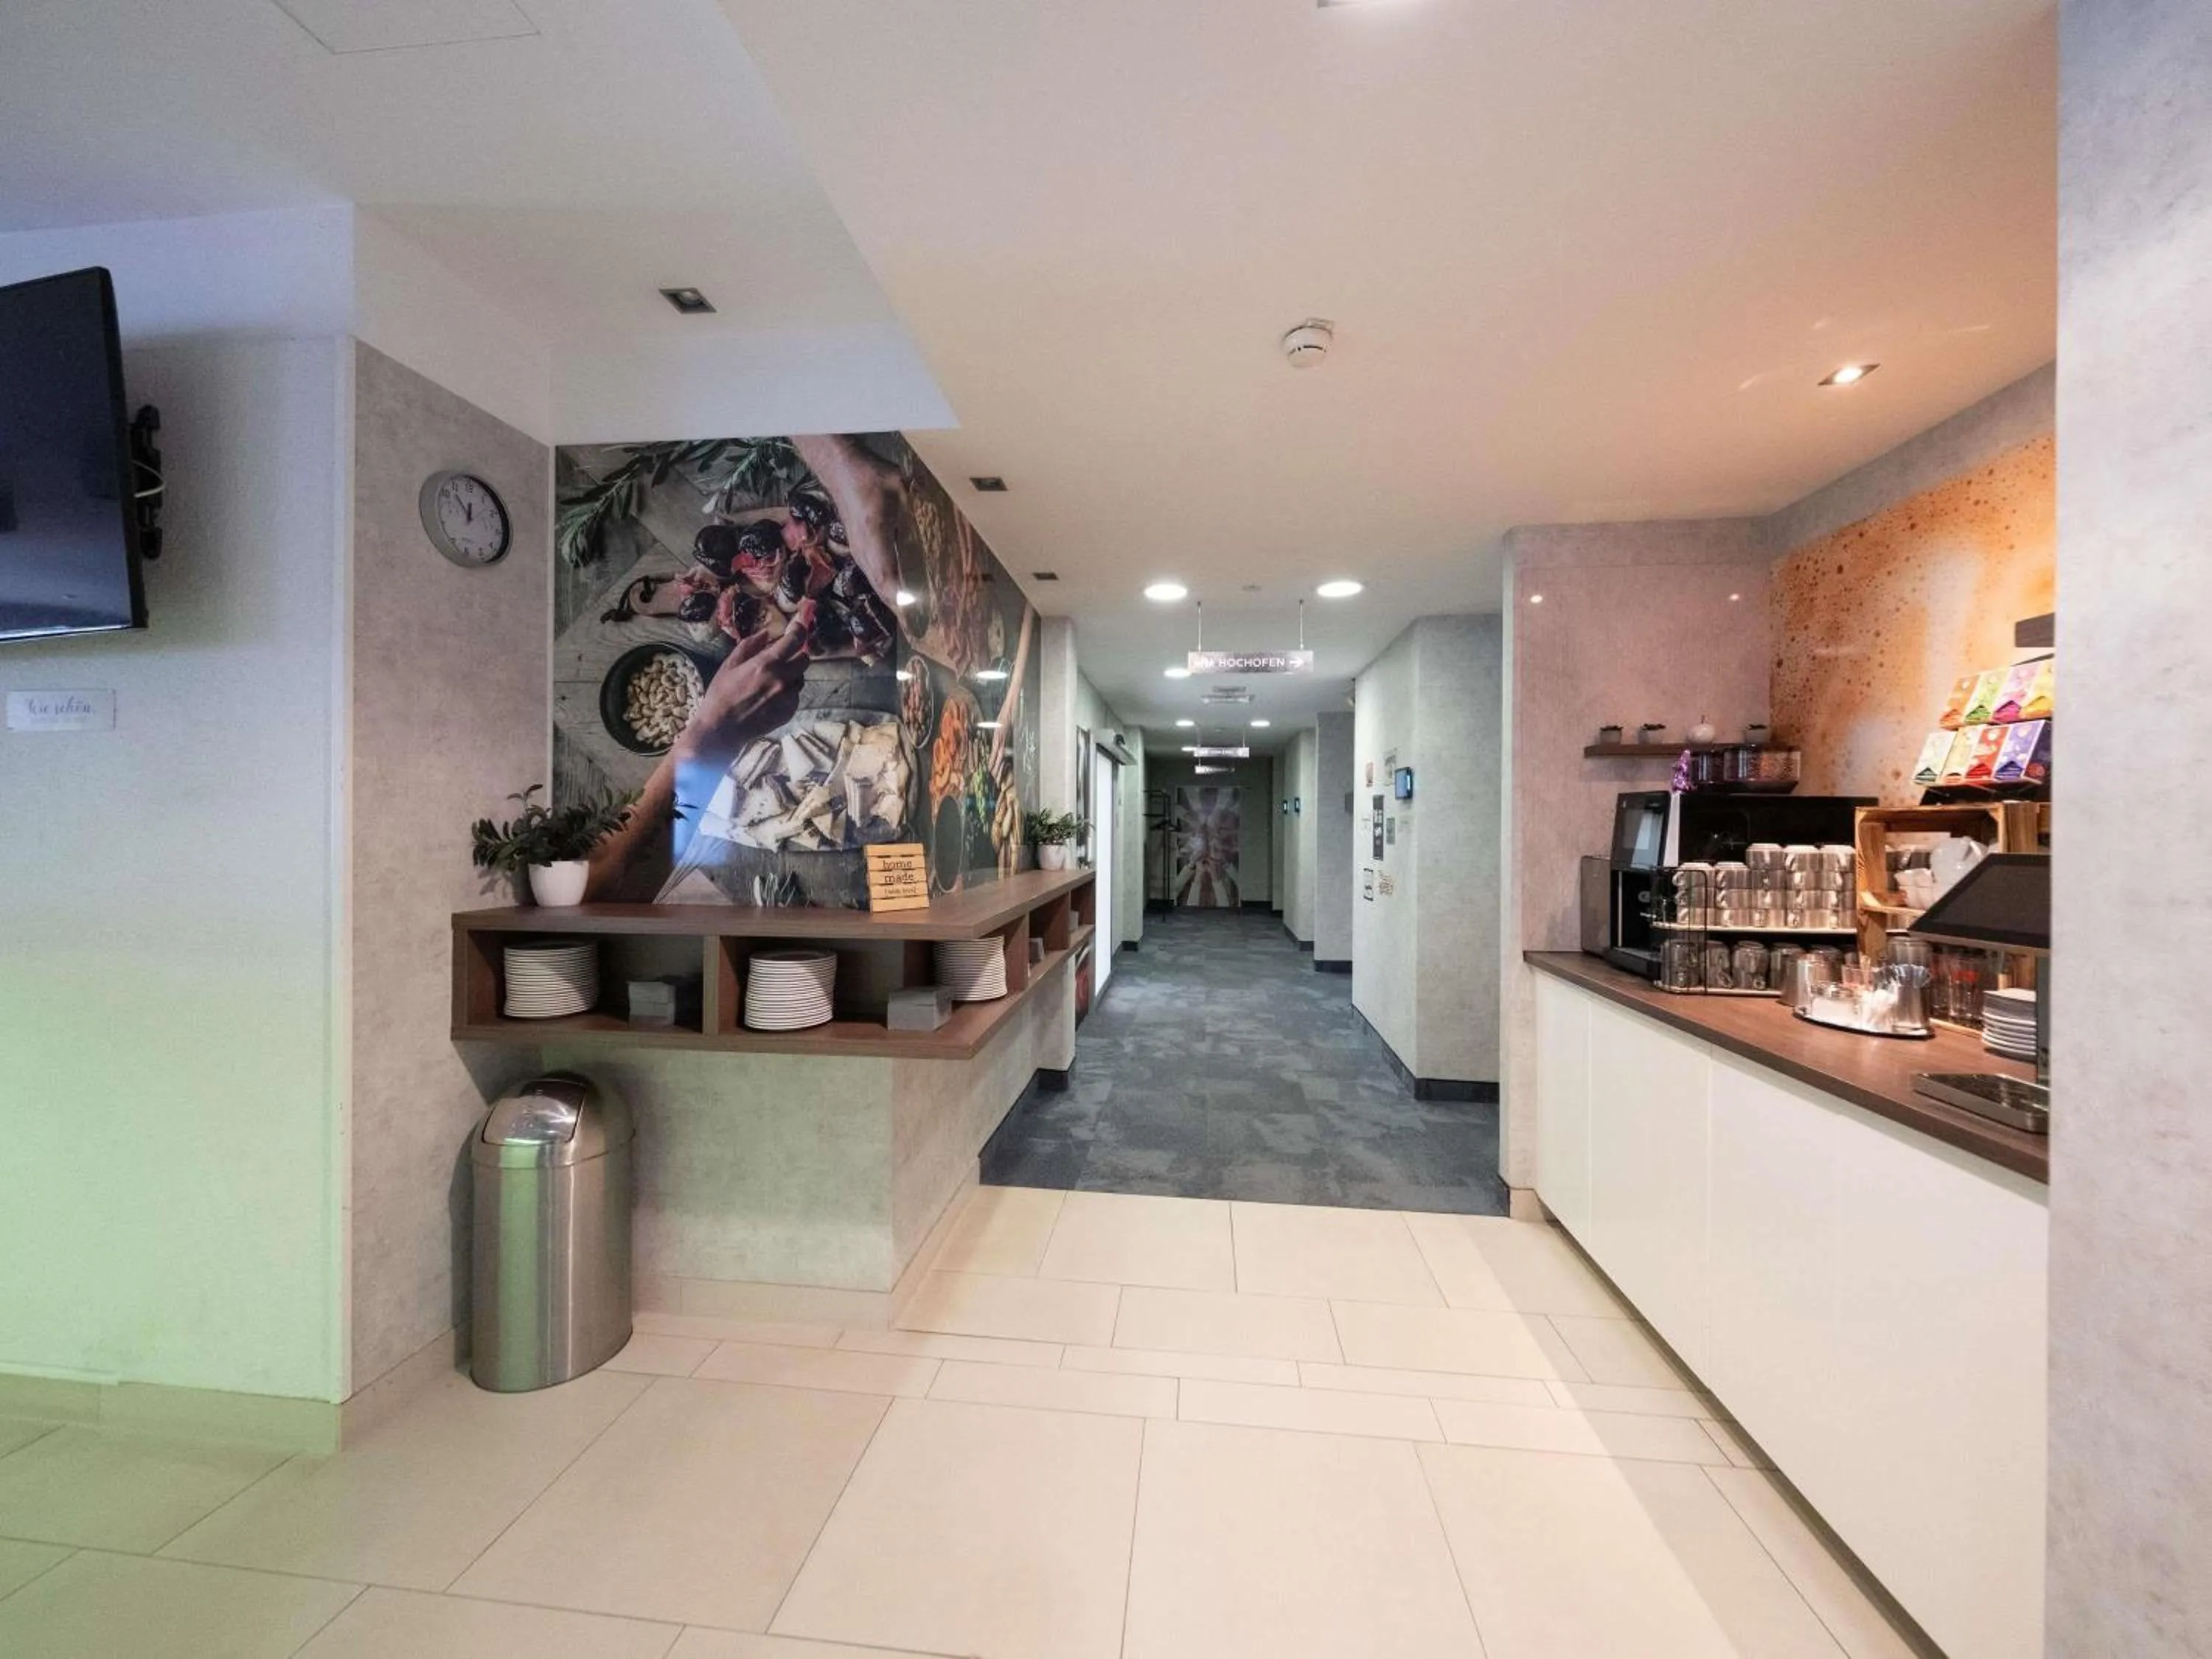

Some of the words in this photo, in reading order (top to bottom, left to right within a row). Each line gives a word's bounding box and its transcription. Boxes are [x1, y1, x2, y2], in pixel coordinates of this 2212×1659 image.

[1218, 657, 1285, 667] HOCHOFEN
[882, 859, 912, 869] home
[884, 872, 914, 883] made
